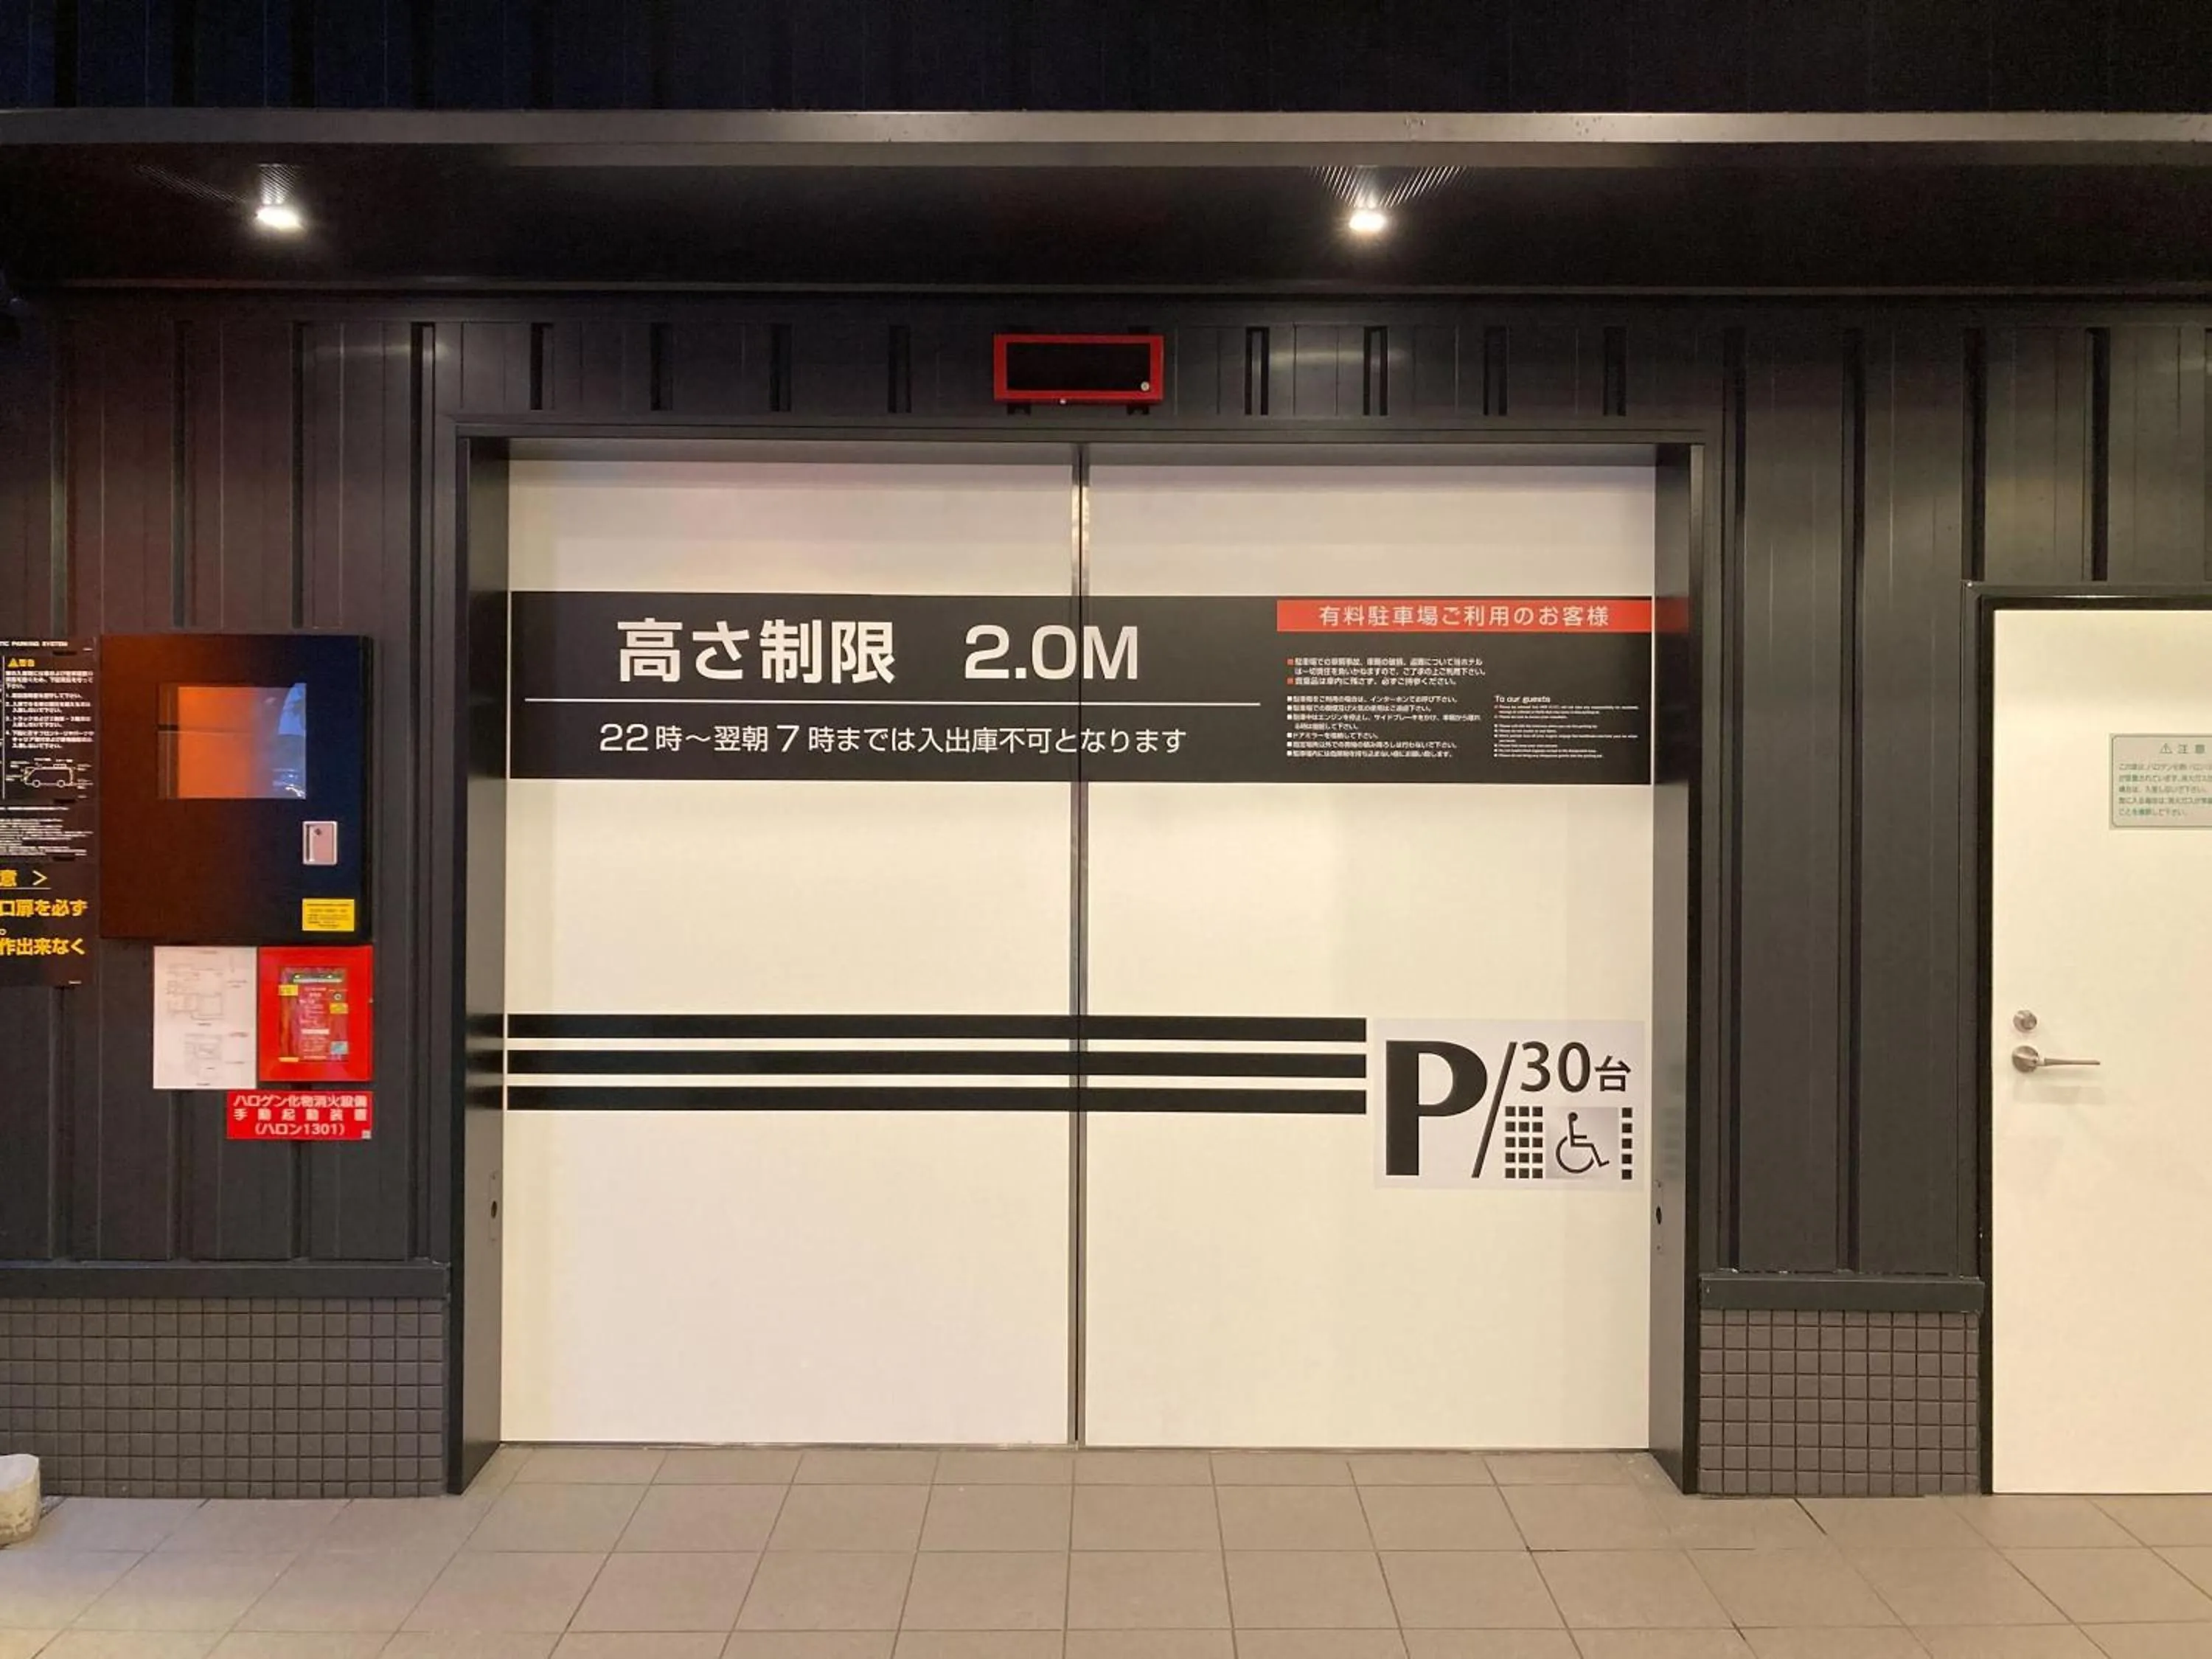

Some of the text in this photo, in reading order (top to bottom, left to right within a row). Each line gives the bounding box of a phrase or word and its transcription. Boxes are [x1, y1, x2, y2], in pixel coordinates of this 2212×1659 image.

[1319, 605, 1610, 627] 有料駐車場ご利用のお客様
[617, 618, 1138, 684] 高さ制限 2.0M
